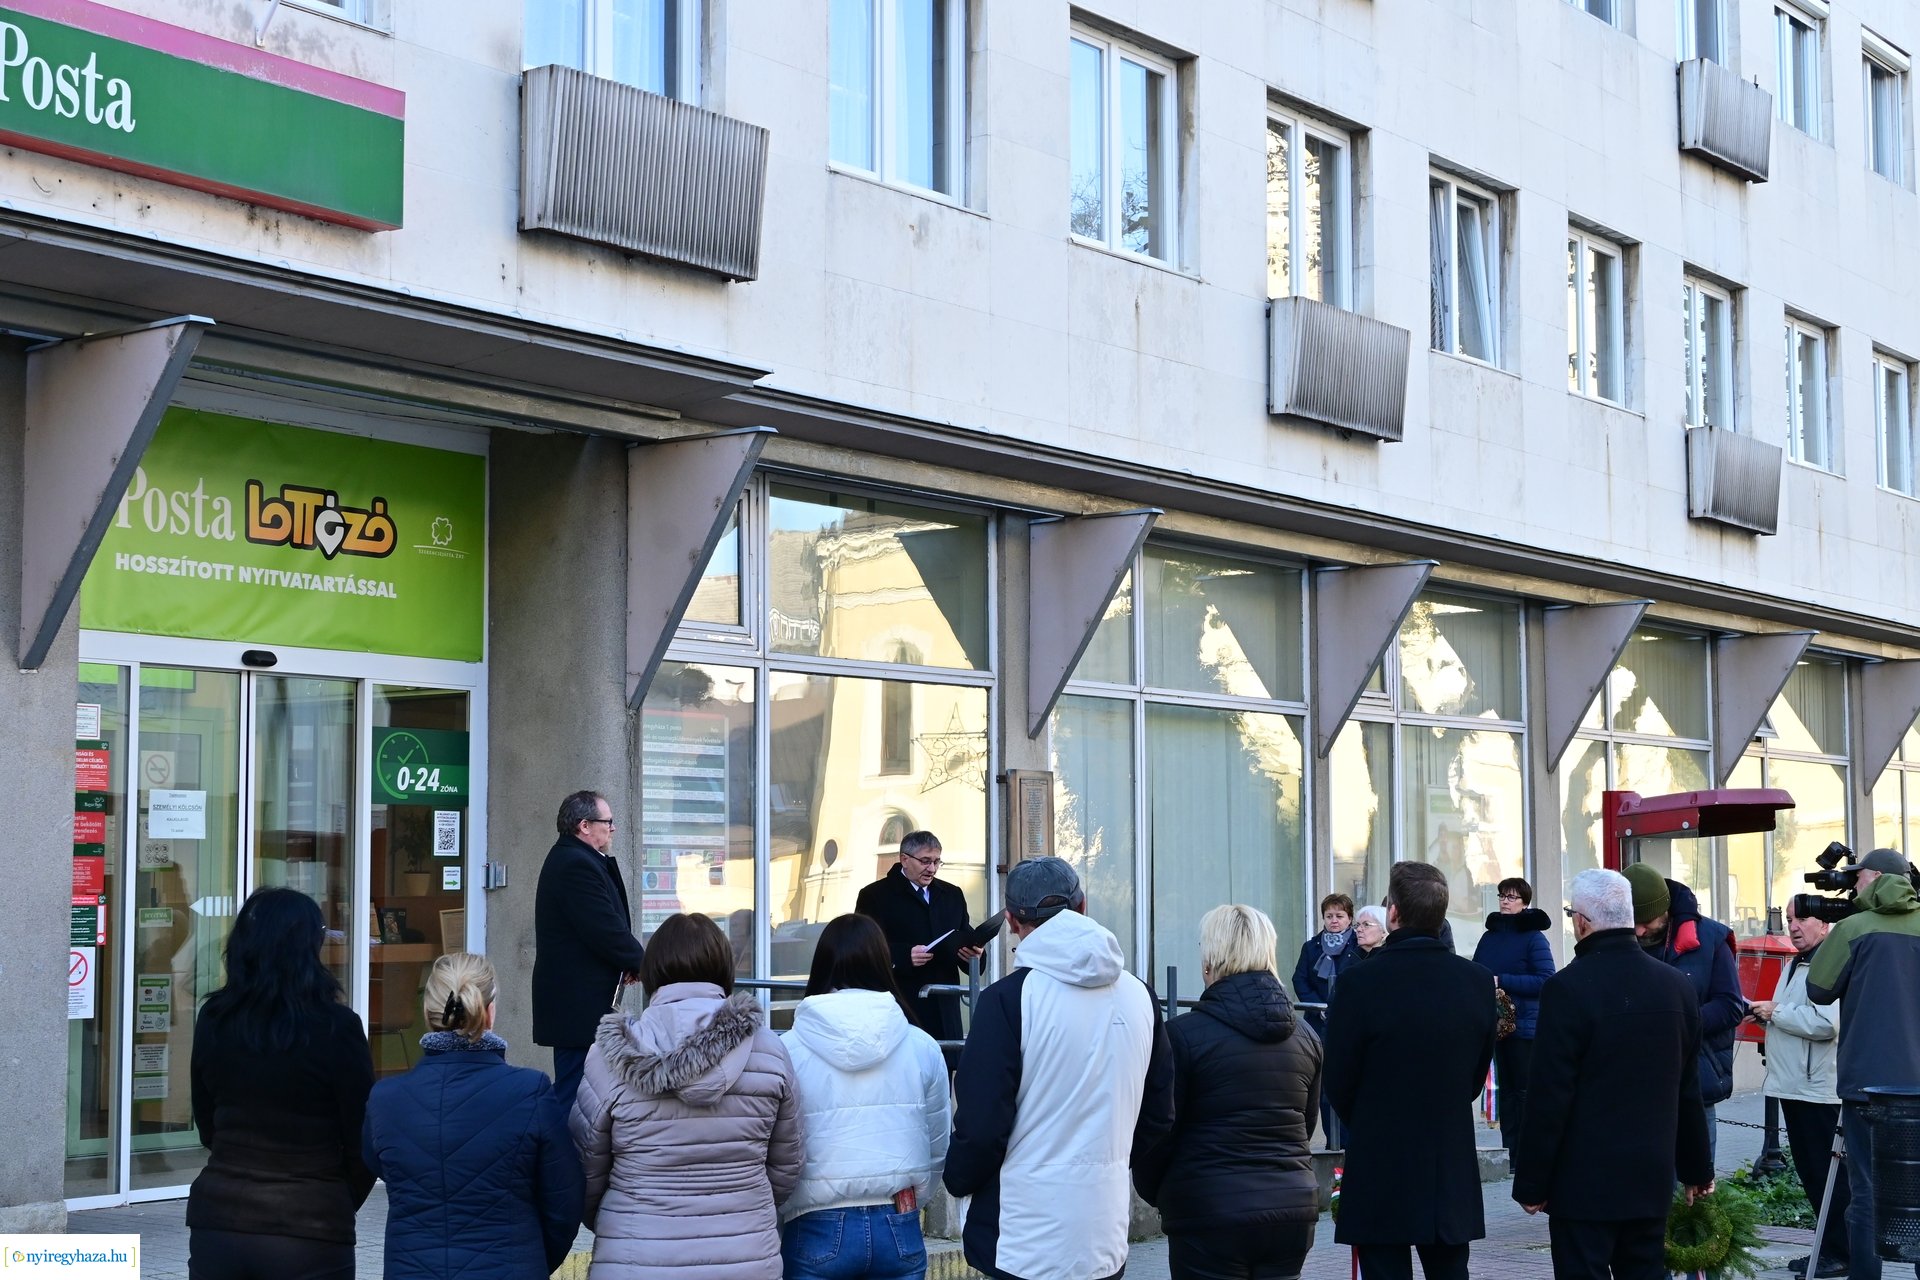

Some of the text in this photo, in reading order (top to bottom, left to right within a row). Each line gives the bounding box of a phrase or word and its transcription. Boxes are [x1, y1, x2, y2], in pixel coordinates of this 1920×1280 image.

[0, 21, 136, 133] Posta
[115, 465, 236, 541] Posta
[115, 552, 397, 599] HOSSZÍTOTT NYITVATARTÁSSAL
[396, 766, 458, 793] 0-24 ZÓNA
[152, 803, 177, 811] SZEMÉLYI
